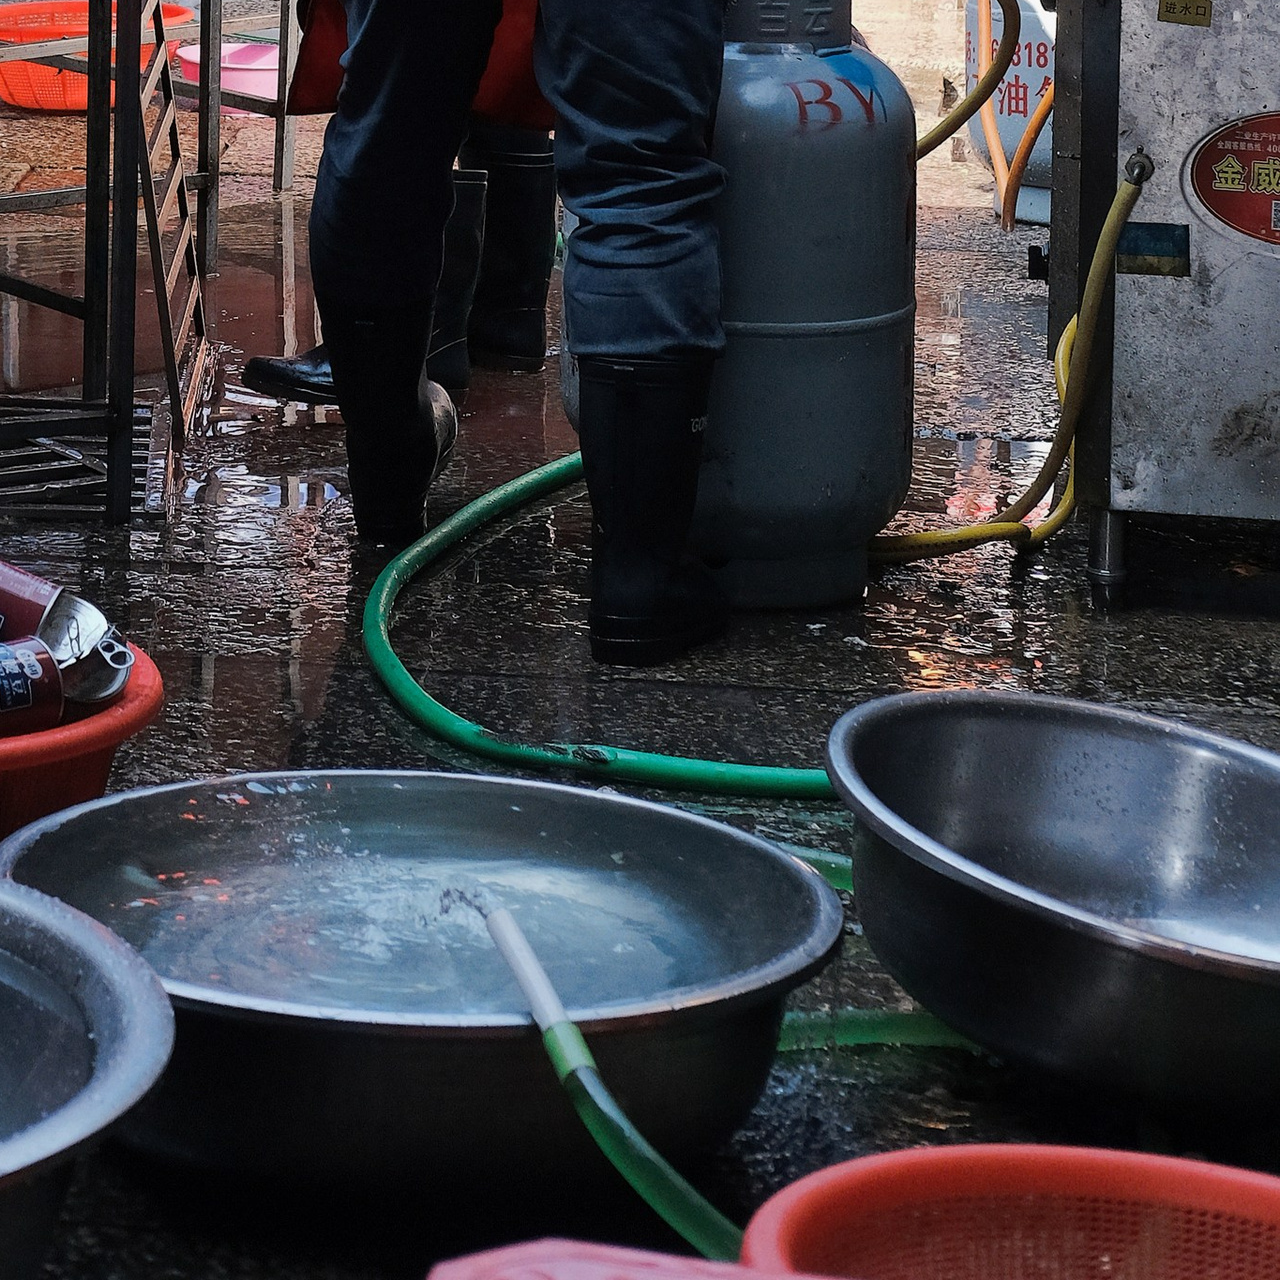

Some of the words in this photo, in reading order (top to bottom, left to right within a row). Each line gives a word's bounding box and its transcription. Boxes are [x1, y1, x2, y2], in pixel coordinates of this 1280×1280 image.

[1164, 1, 1207, 17] 进水口
[784, 76, 877, 133] BY
